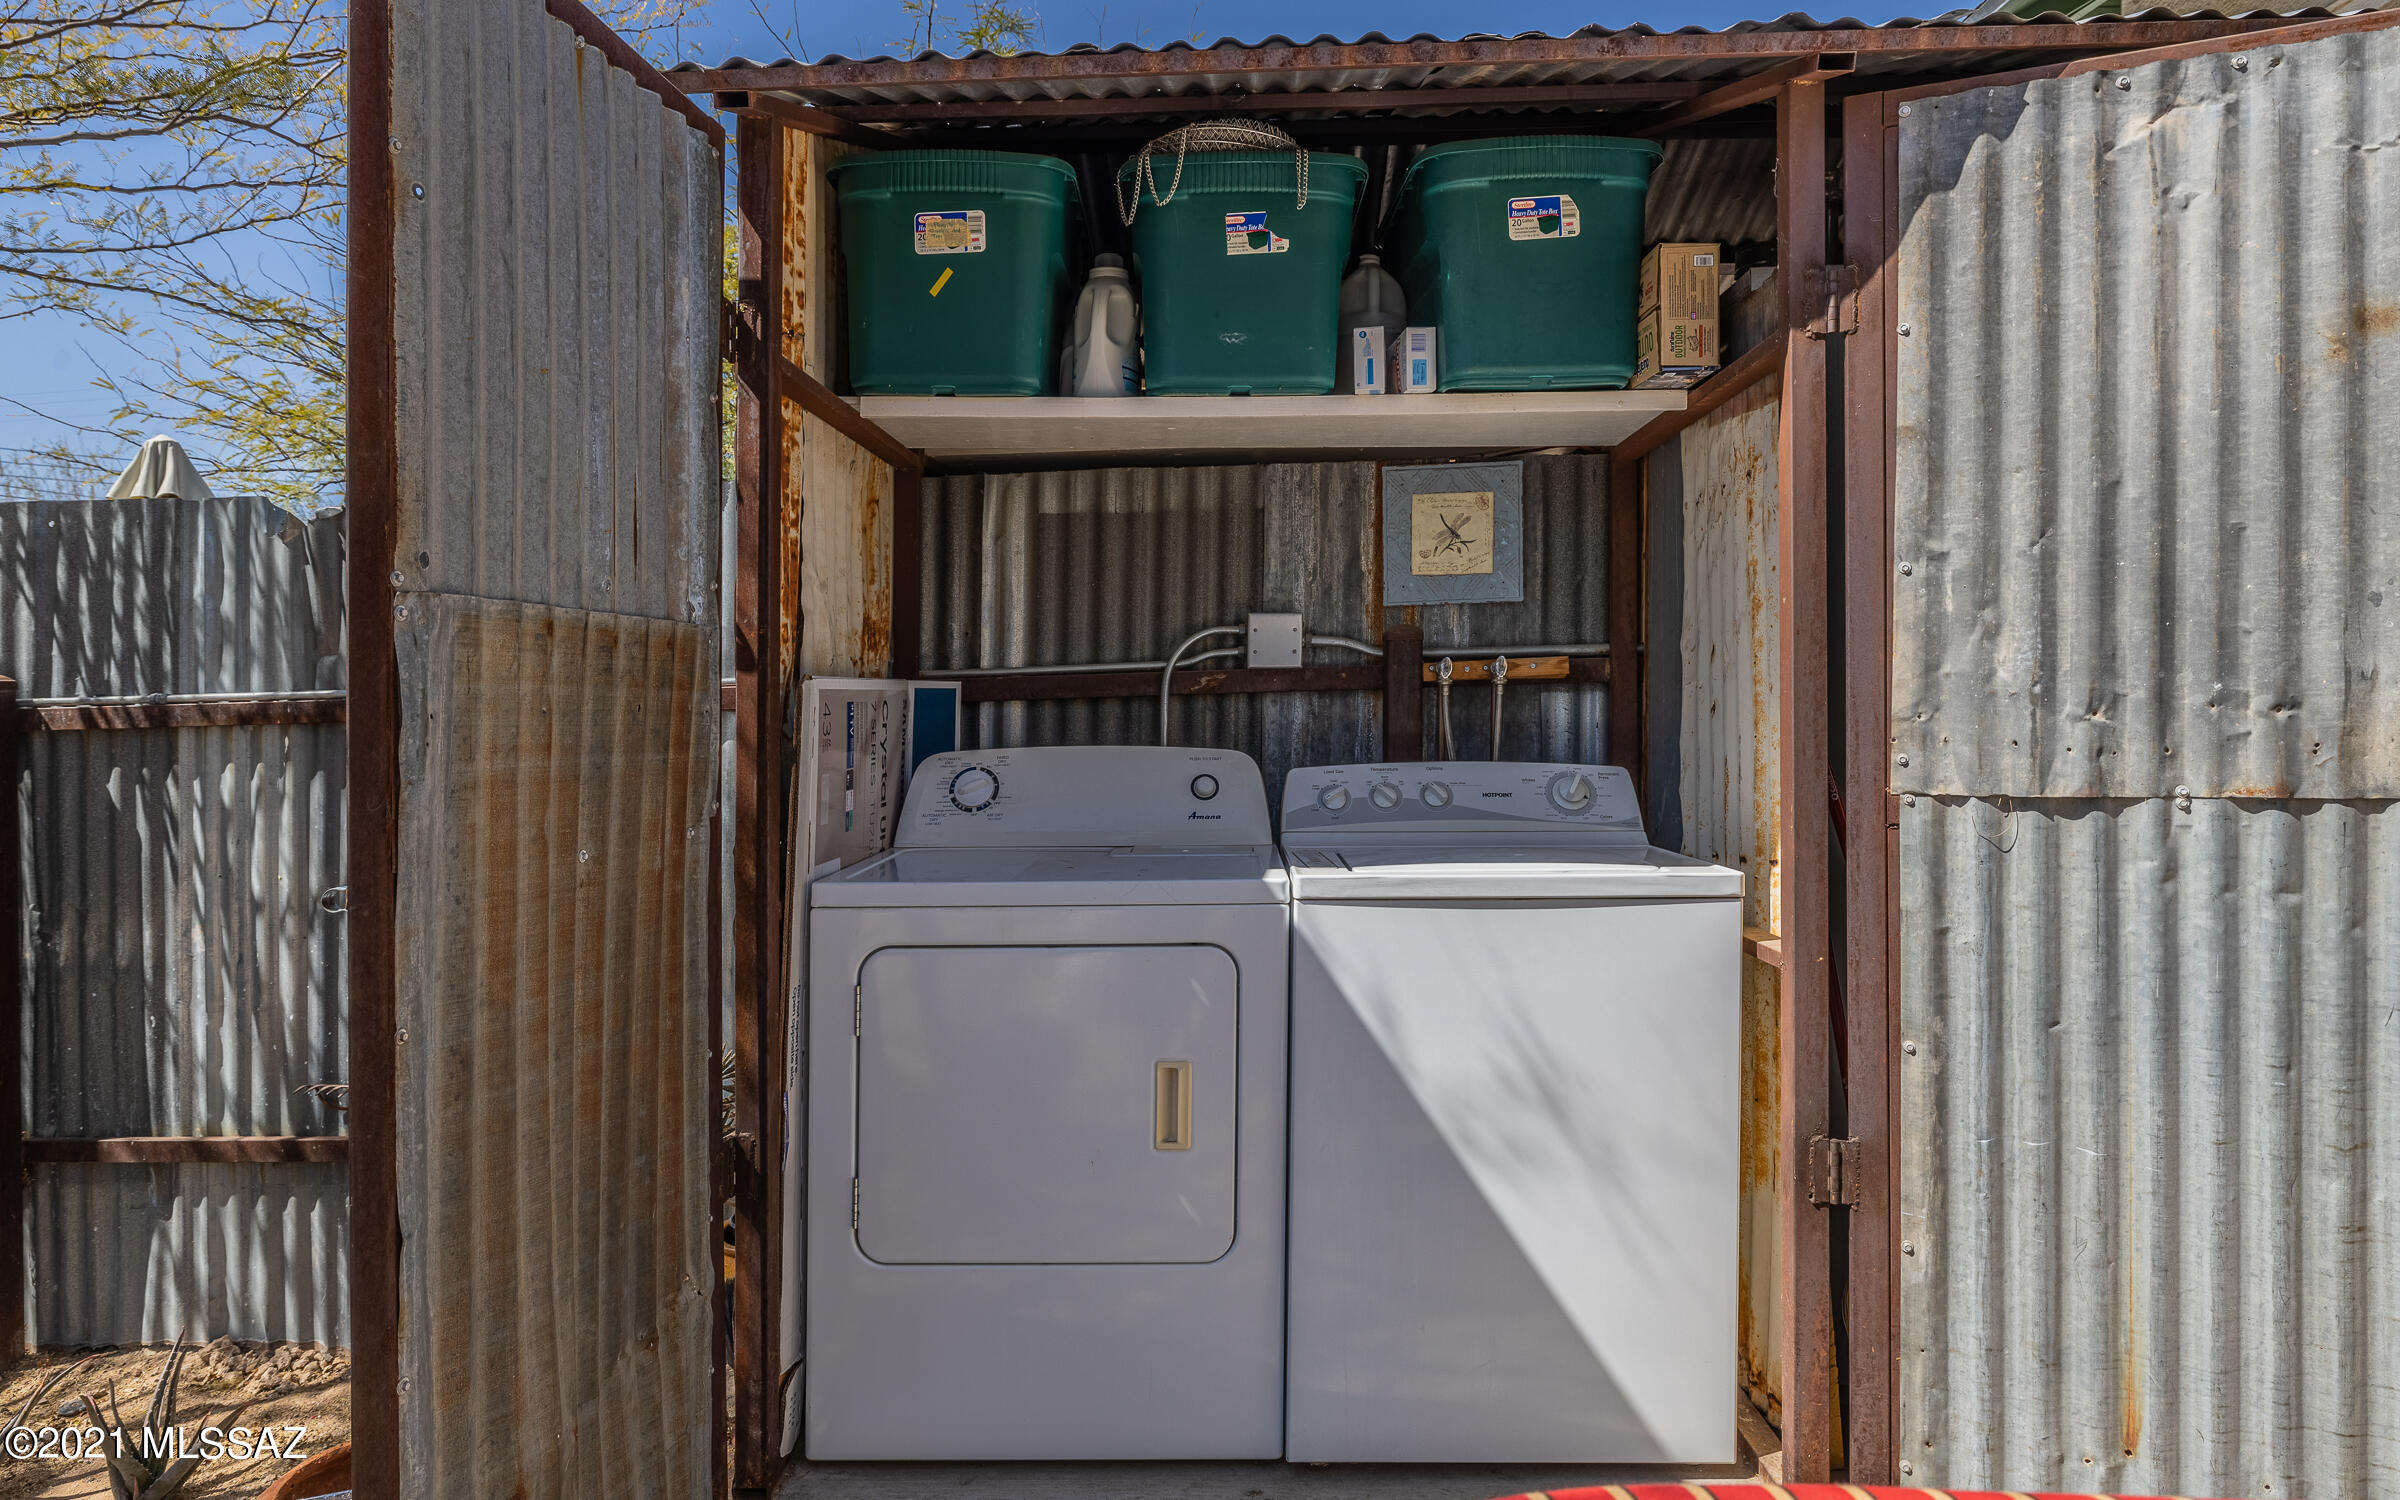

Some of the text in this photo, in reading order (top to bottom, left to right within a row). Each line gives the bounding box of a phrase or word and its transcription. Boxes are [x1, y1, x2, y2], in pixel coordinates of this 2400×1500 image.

[1512, 218, 1522, 226] 20
[1675, 325, 1683, 358] OUTDOOR
[872, 702, 876, 712] 7
[822, 702, 832, 737] 43
[880, 700, 888, 852] Crystal UH
[1188, 811, 1221, 820] Amana
